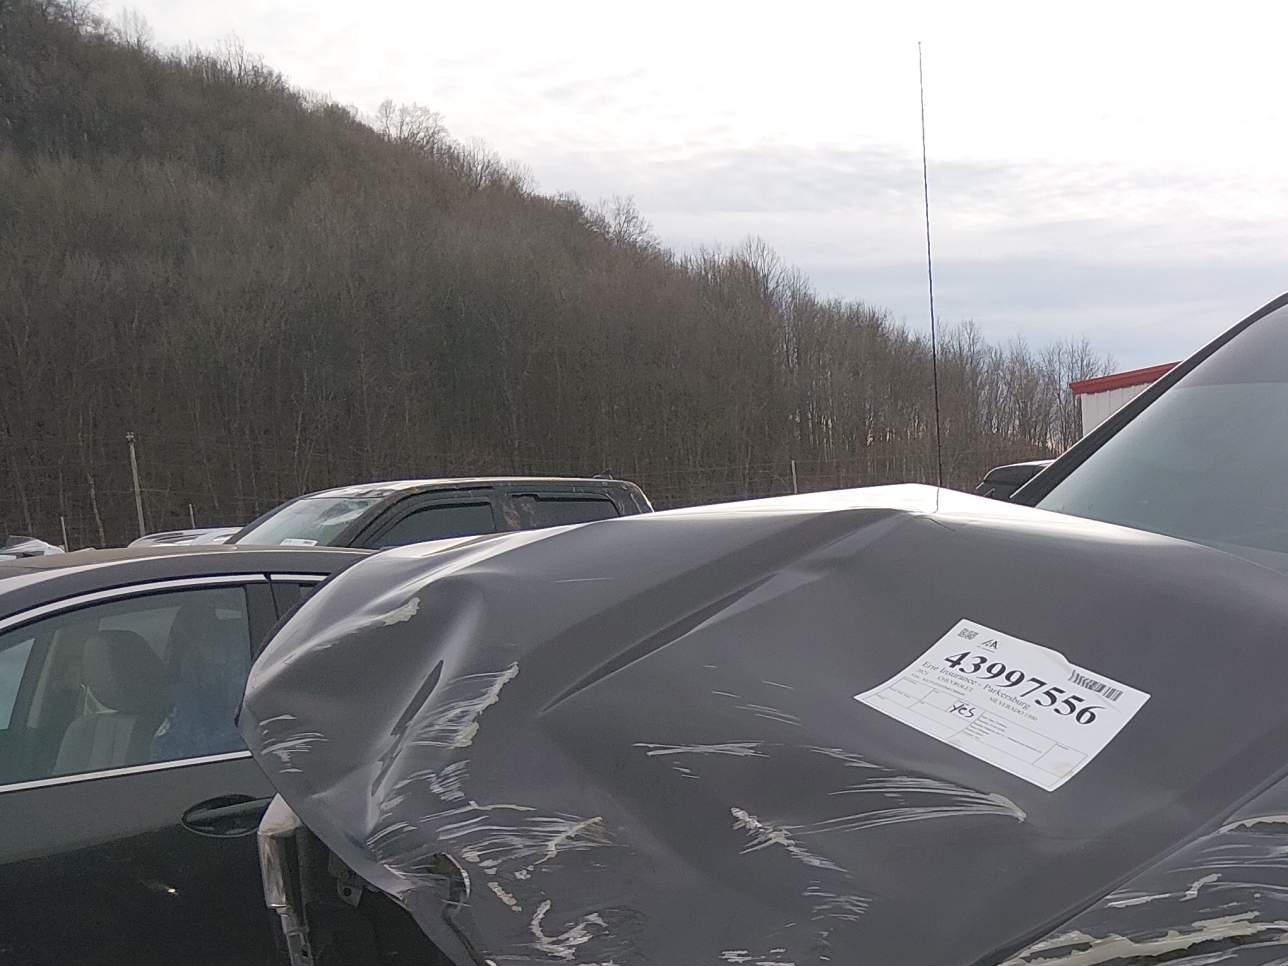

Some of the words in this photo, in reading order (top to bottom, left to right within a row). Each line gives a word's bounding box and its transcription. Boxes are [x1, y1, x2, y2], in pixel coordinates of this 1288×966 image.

[922, 660, 939, 671] Erie
[940, 666, 978, 686] Insurance
[983, 683, 1032, 710] Parkersburg
[943, 650, 1107, 724] 43997556
